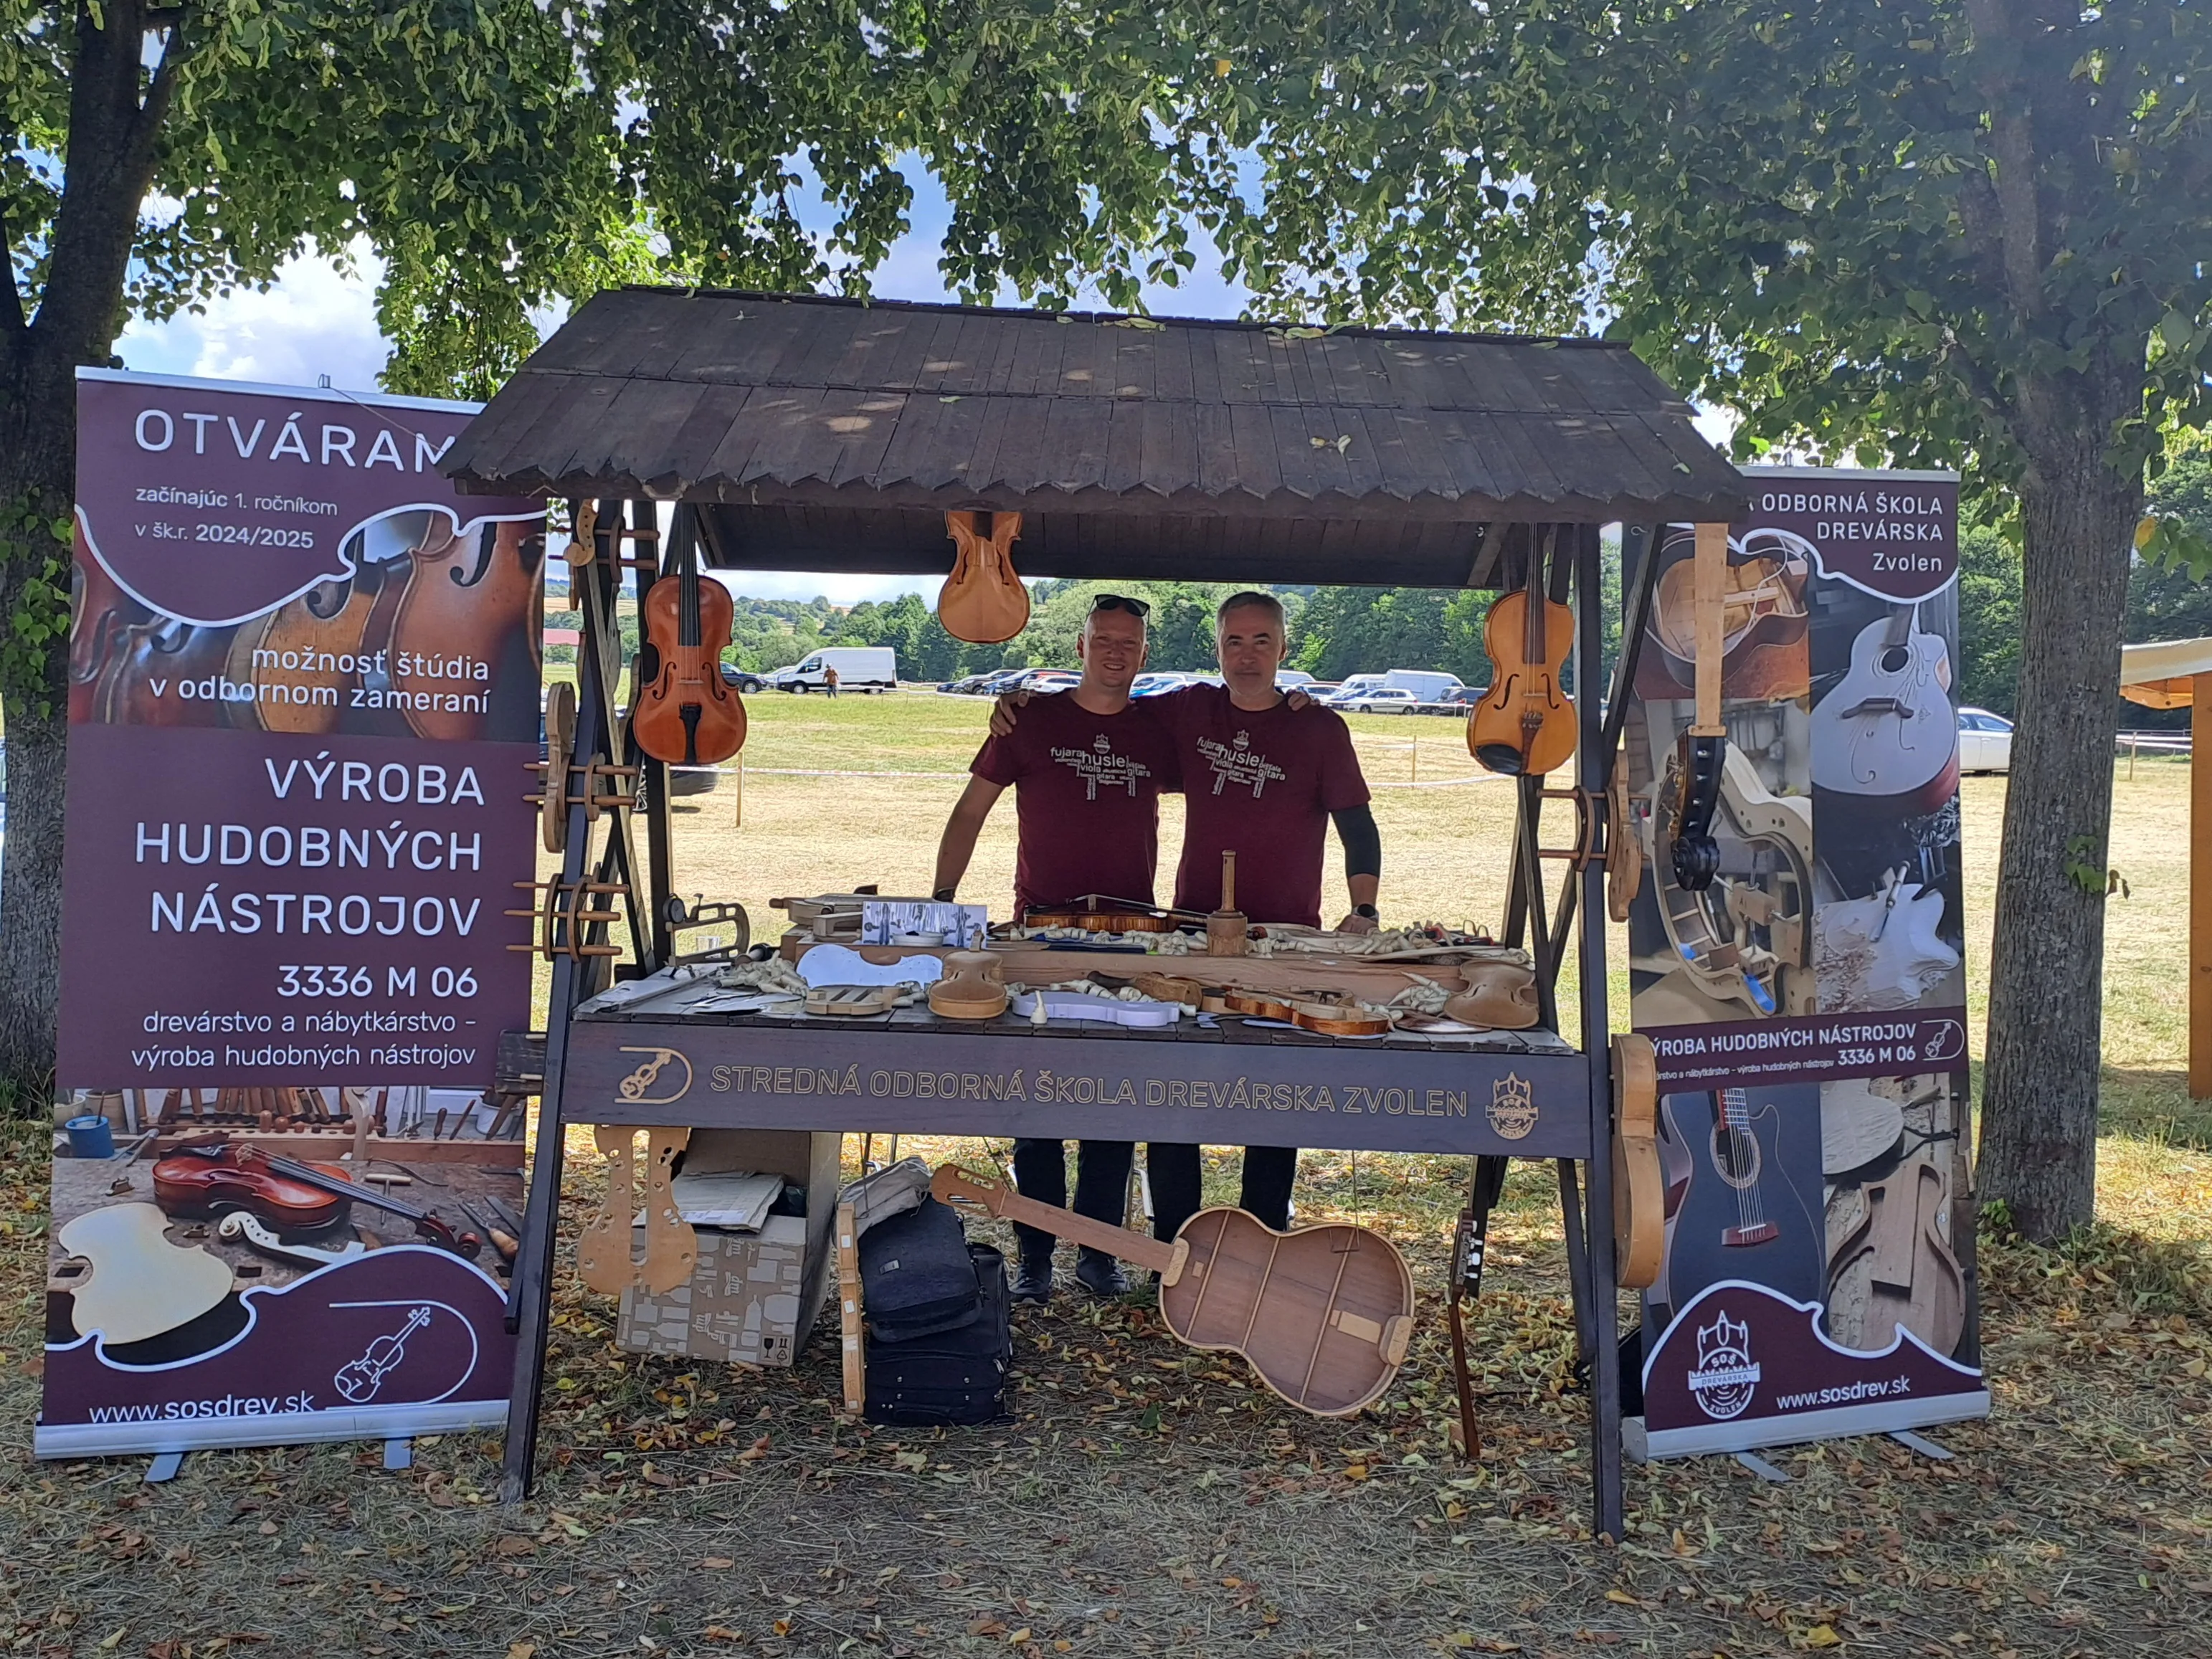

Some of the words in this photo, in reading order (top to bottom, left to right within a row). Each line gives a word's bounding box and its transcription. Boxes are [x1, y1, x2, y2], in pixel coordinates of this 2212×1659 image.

[136, 487, 229, 510] začínajúc
[235, 493, 247, 509] 1.
[254, 493, 338, 516] ročníkom
[1762, 491, 1869, 513] ODBORNÁ
[1876, 491, 1943, 515] ŠKOLA
[135, 526, 146, 539] v
[152, 521, 189, 541] šk.r.
[196, 524, 314, 548] 2024/2025
[1817, 518, 1943, 541] DREVÁRSKA
[1872, 552, 1942, 571] Zvolen
[252, 645, 386, 675] možnosť
[397, 650, 490, 681] štúdia
[149, 680, 168, 698] v
[179, 676, 338, 706] odbornom
[351, 687, 491, 713] zameraní
[1050, 747, 1082, 759] fujara
[1081, 751, 1126, 767] husle
[1197, 736, 1221, 751] fujara
[1218, 744, 1260, 767] husle
[1215, 758, 1233, 769] viola
[265, 751, 485, 806] VÝROBA
[1081, 764, 1101, 773] viola
[1126, 769, 1151, 778] gitara
[1258, 768, 1286, 781] gitara
[135, 820, 481, 871] HUDOBNÝCH
[151, 883, 481, 936] NÁSTROJOV
[277, 965, 374, 997] 3336
[387, 967, 417, 997] M
[431, 967, 478, 998] 06
[143, 1010, 272, 1034] drevárstvo
[280, 1017, 295, 1032] a
[305, 1009, 456, 1037] nábytkárstvo
[1650, 1037, 1706, 1057] ÝROBA
[1711, 1027, 1813, 1053] HUDOBNÝCH
[1819, 1023, 1917, 1045] NÁSTROJOV
[131, 1044, 214, 1071] výroba
[224, 1044, 359, 1071] hudobných
[370, 1043, 476, 1070] nástrojov
[1656, 1070, 1677, 1080] árstvo
[1685, 1067, 1729, 1080] nábytkárstvo
[1737, 1064, 1760, 1075] výroba
[1762, 1061, 1802, 1073] hudobných
[1803, 1059, 1835, 1070] nástrojov
[1838, 1049, 1875, 1066] 3336
[1879, 1048, 1892, 1063] M
[1896, 1046, 1917, 1062] 06
[710, 1064, 862, 1097] STREDNÁ
[869, 1069, 1027, 1103] ODBORNÁ
[1034, 1070, 1136, 1106] ŠKOLA
[1144, 1078, 1336, 1113] DREVÁRSKA
[1342, 1086, 1468, 1118] ZVOLEN
[1711, 1353, 1737, 1368] SOŠ
[1776, 1374, 1911, 1410] www.sosdrev.sk
[88, 1389, 315, 1424] www.sosdrev.sk
[1710, 1401, 1742, 1414] ZVOLEN
